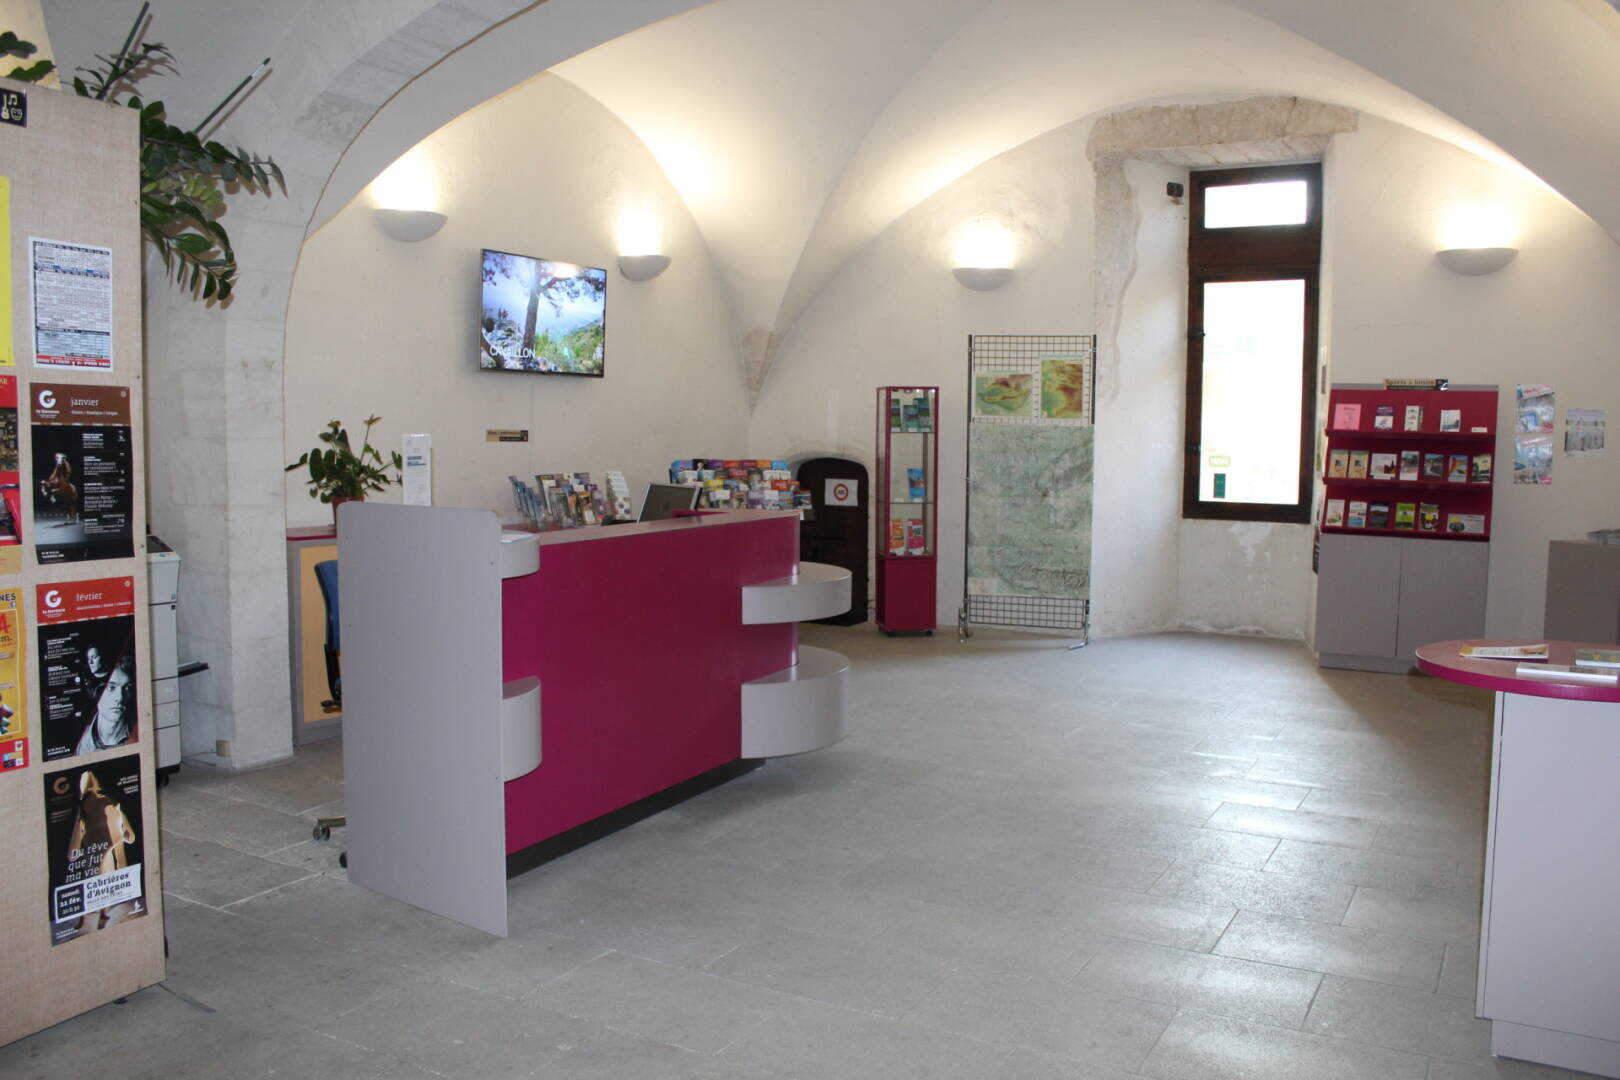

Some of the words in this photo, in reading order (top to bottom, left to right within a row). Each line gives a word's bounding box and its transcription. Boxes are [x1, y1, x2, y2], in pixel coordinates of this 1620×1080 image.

[70, 396, 99, 408] janvier
[86, 841, 109, 855] rêve
[68, 859, 87, 873] que
[65, 872, 82, 883] ma
[84, 865, 100, 877] vie
